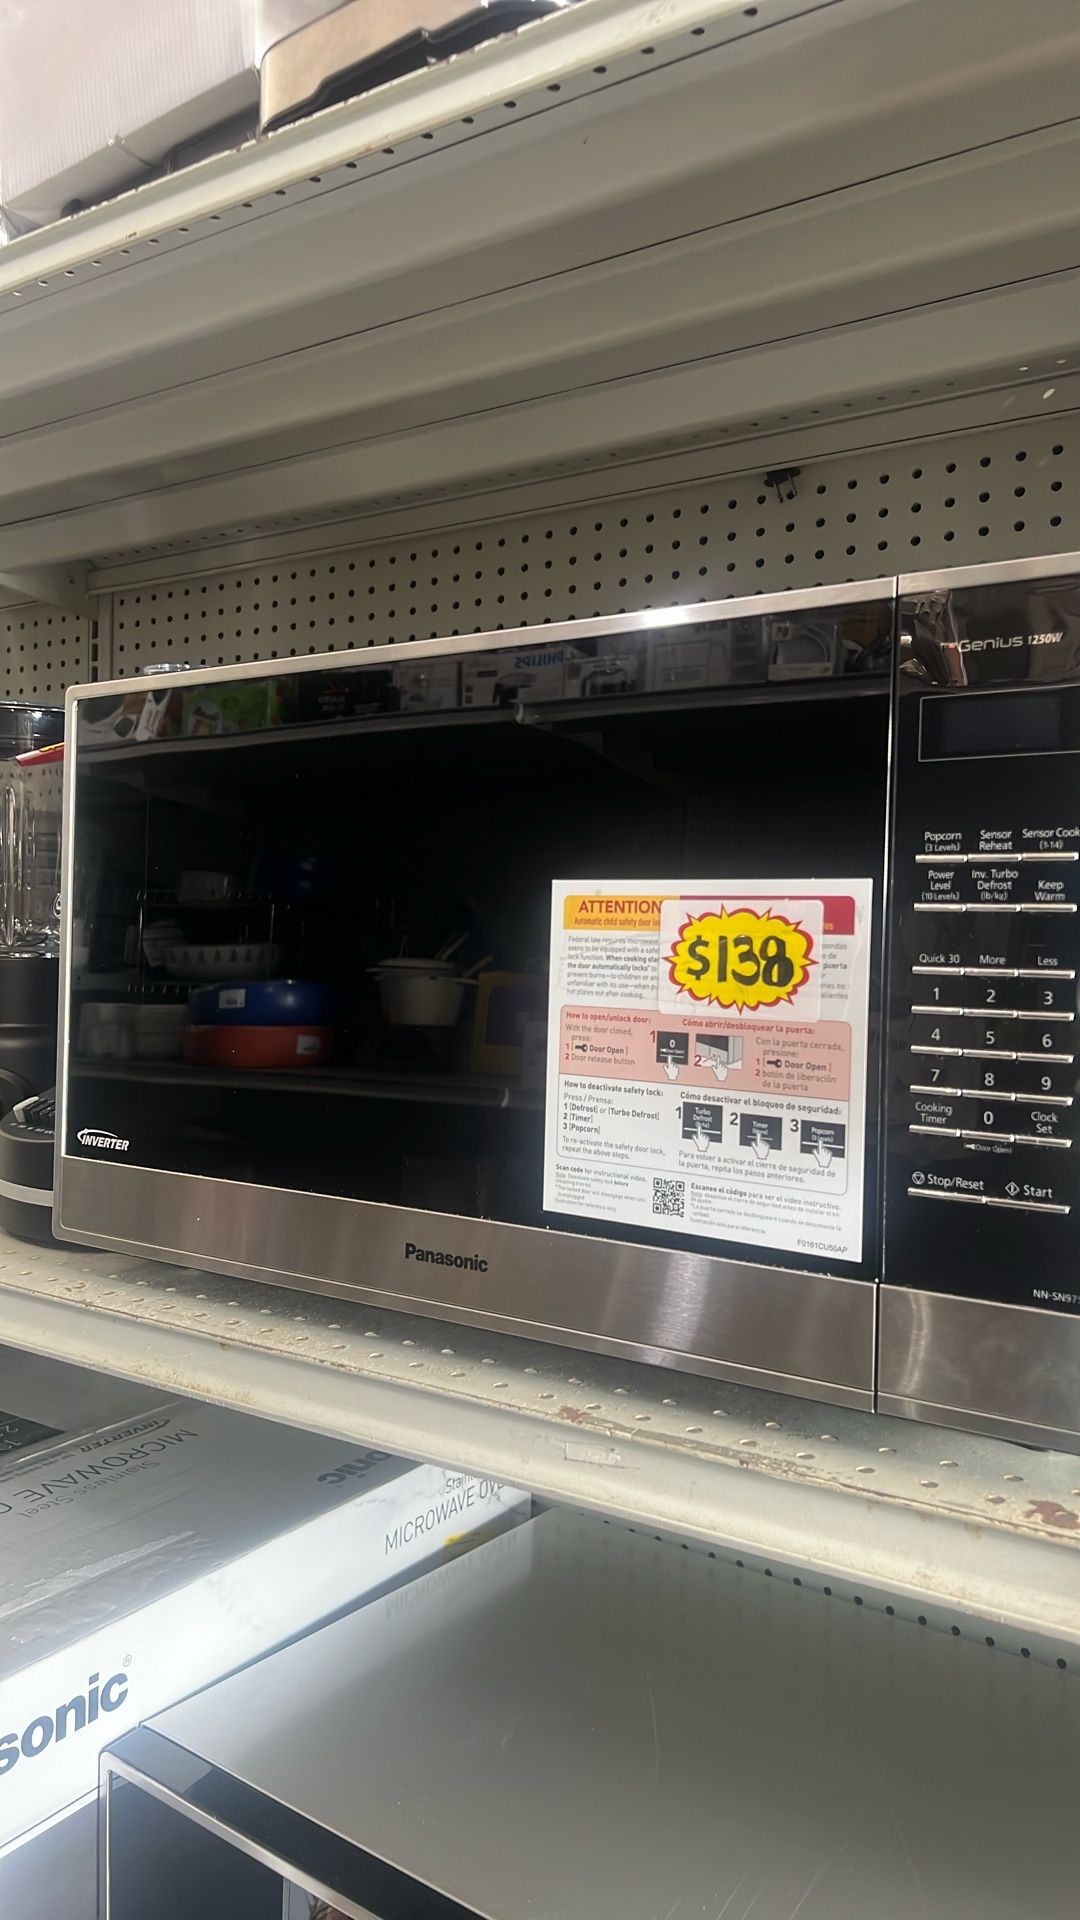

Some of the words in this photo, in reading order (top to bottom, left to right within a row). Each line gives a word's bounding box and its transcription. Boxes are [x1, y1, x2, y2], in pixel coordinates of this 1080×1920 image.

[958, 636, 1023, 652] Genius
[1027, 632, 1064, 645] 1250W
[924, 831, 962, 842] Popcorn
[980, 829, 1012, 840] Sensor
[1022, 828, 1055, 839] Sensor
[1055, 826, 1080, 837] Cook
[934, 842, 961, 851] Levels)
[979, 840, 1013, 850] Reheat
[1039, 840, 1064, 850] (1-14)
[928, 870, 955, 879] Power
[971, 869, 989, 879] Inv.
[990, 868, 1019, 879] Turbo
[930, 880, 951, 890] Level
[977, 880, 1012, 890] Defrost
[1038, 880, 1064, 892] Keep
[921, 891, 933, 901] (10
[934, 891, 960, 900] Levels)
[980, 891, 1008, 901] (lb/kg)
[1034, 891, 1066, 901] Warm
[578, 900, 662, 914] ATTENTION
[623, 955, 647, 964] cooking
[686, 934, 795, 987] $138
[918, 953, 945, 963] Quick
[947, 954, 960, 964] 30
[979, 954, 1006, 964] More
[1037, 956, 1058, 966] Less
[577, 962, 591, 970] door
[591, 963, 631, 972] automatically
[932, 987, 940, 1000] 1
[985, 989, 996, 1003] 2
[1043, 991, 1054, 1005] 3
[566, 1011, 580, 1019] How
[589, 1013, 632, 1023] open/unlock
[581, 1024, 592, 1032] the
[682, 1018, 703, 1027] Cómo
[704, 1020, 774, 1033] abrir/desbloquear
[785, 1025, 815, 1035] puerta:
[649, 1030, 656, 1043] 1
[931, 1028, 941, 1041] 4
[985, 1031, 995, 1044] 5
[1041, 1034, 1053, 1048] 6
[589, 1044, 605, 1053] Door
[606, 1046, 624, 1055] Open
[669, 1039, 676, 1049] 0
[755, 1037, 771, 1045] Con
[781, 1039, 808, 1049] puerta
[571, 1053, 586, 1061] Door
[587, 1054, 612, 1063] release
[784, 1059, 803, 1069] Door
[805, 1062, 827, 1072] Open
[796, 1073, 837, 1084] liberación
[931, 1069, 940, 1082] 7
[984, 1072, 995, 1086] 8
[564, 1080, 579, 1088] How
[587, 1082, 622, 1093] deactivate
[623, 1086, 645, 1097] safety
[782, 1082, 809, 1092] puerta
[1041, 1076, 1052, 1091] 9
[563, 1092, 583, 1101] Press
[680, 1091, 701, 1101] Cómo
[702, 1093, 742, 1105] desactivar
[743, 1097, 751, 1106] el
[752, 1098, 785, 1111] bloqueo
[785, 1102, 796, 1112] de
[675, 1106, 682, 1120] 1
[915, 1101, 953, 1115] Cooking
[729, 1111, 739, 1126] 2
[920, 1113, 948, 1124] Timer
[983, 1111, 994, 1125] 0
[1030, 1111, 1058, 1124] Clock
[790, 1118, 800, 1133] 3
[1035, 1123, 1053, 1135] Set
[80, 1133, 130, 1151] INVERTER
[614, 1142, 634, 1152] safety
[634, 1144, 649, 1153] door
[592, 1148, 611, 1157] above
[555, 1163, 570, 1171] Scan
[570, 1165, 584, 1173] code
[678, 1150, 695, 1160] Para
[695, 1153, 716, 1162] volver
[722, 1156, 746, 1165] activar
[755, 1161, 777, 1170] cierre
[788, 1165, 825, 1177] seguridad
[711, 1163, 732, 1174] repita
[743, 1169, 765, 1178] pasos
[927, 1173, 985, 1191] Stop/Reset
[690, 1182, 718, 1193] Escanee
[726, 1187, 748, 1198] código
[1023, 1184, 1053, 1198] Start
[405, 1242, 489, 1273] Panasonic
[13, 1428, 199, 1503] MICROWAVE
[73, 1459, 161, 1495] Stainless
[17, 1495, 75, 1519] Steel
[385, 1485, 476, 1555] MICROWAVE
